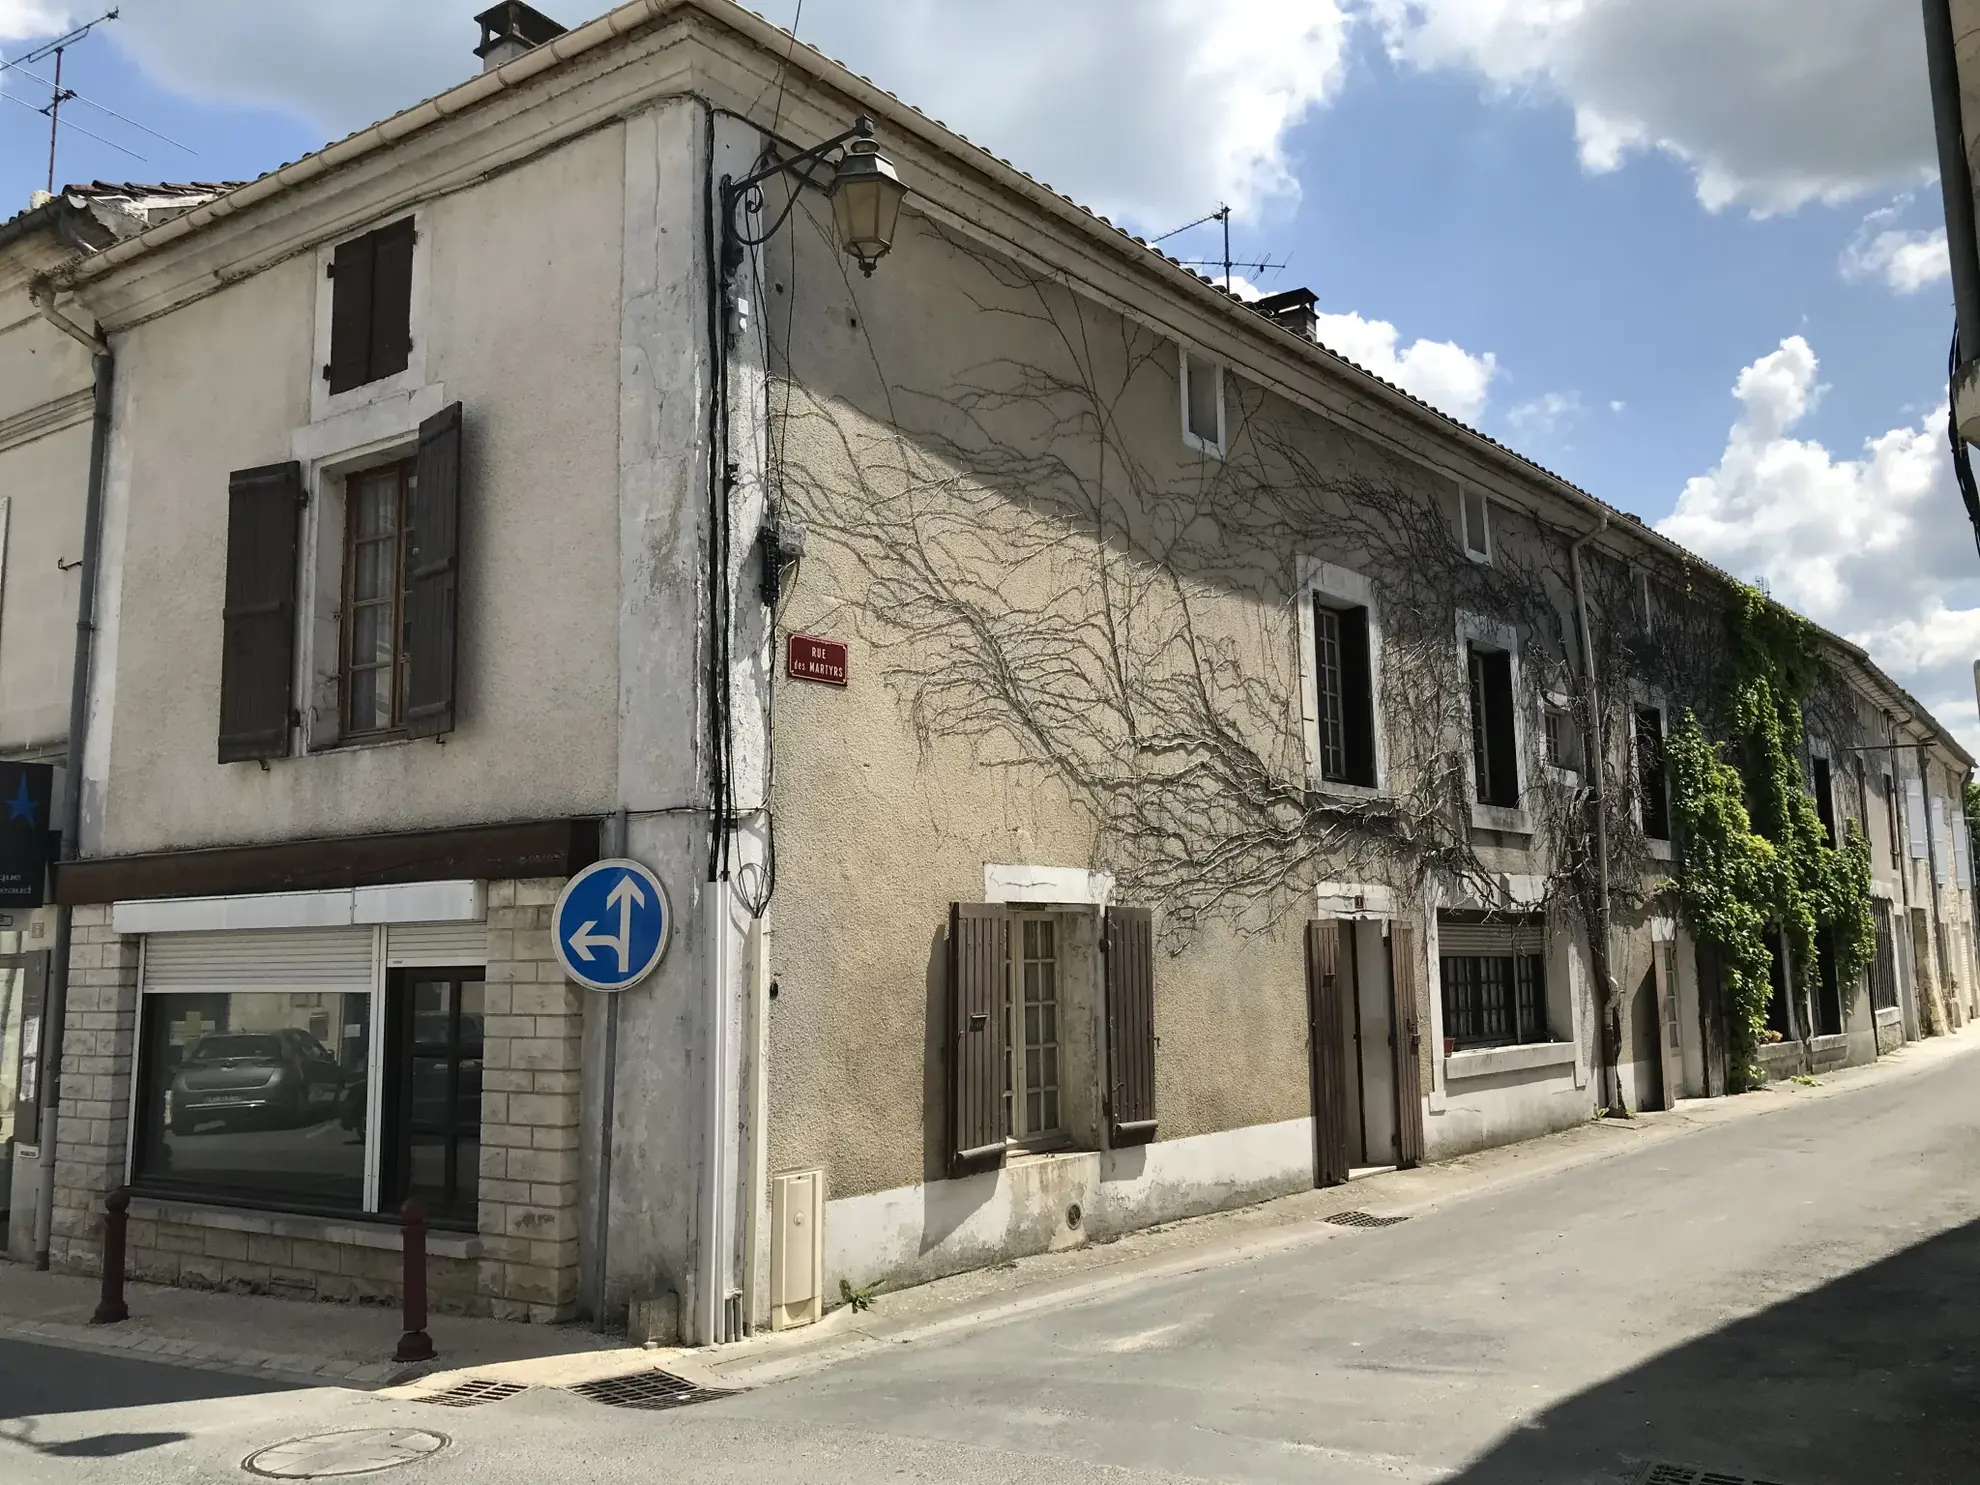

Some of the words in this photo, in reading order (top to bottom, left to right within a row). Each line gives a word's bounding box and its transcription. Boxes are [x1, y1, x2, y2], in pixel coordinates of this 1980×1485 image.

[811, 647, 826, 659] RUE
[794, 659, 805, 670] des
[809, 661, 843, 677] MARTYRS
